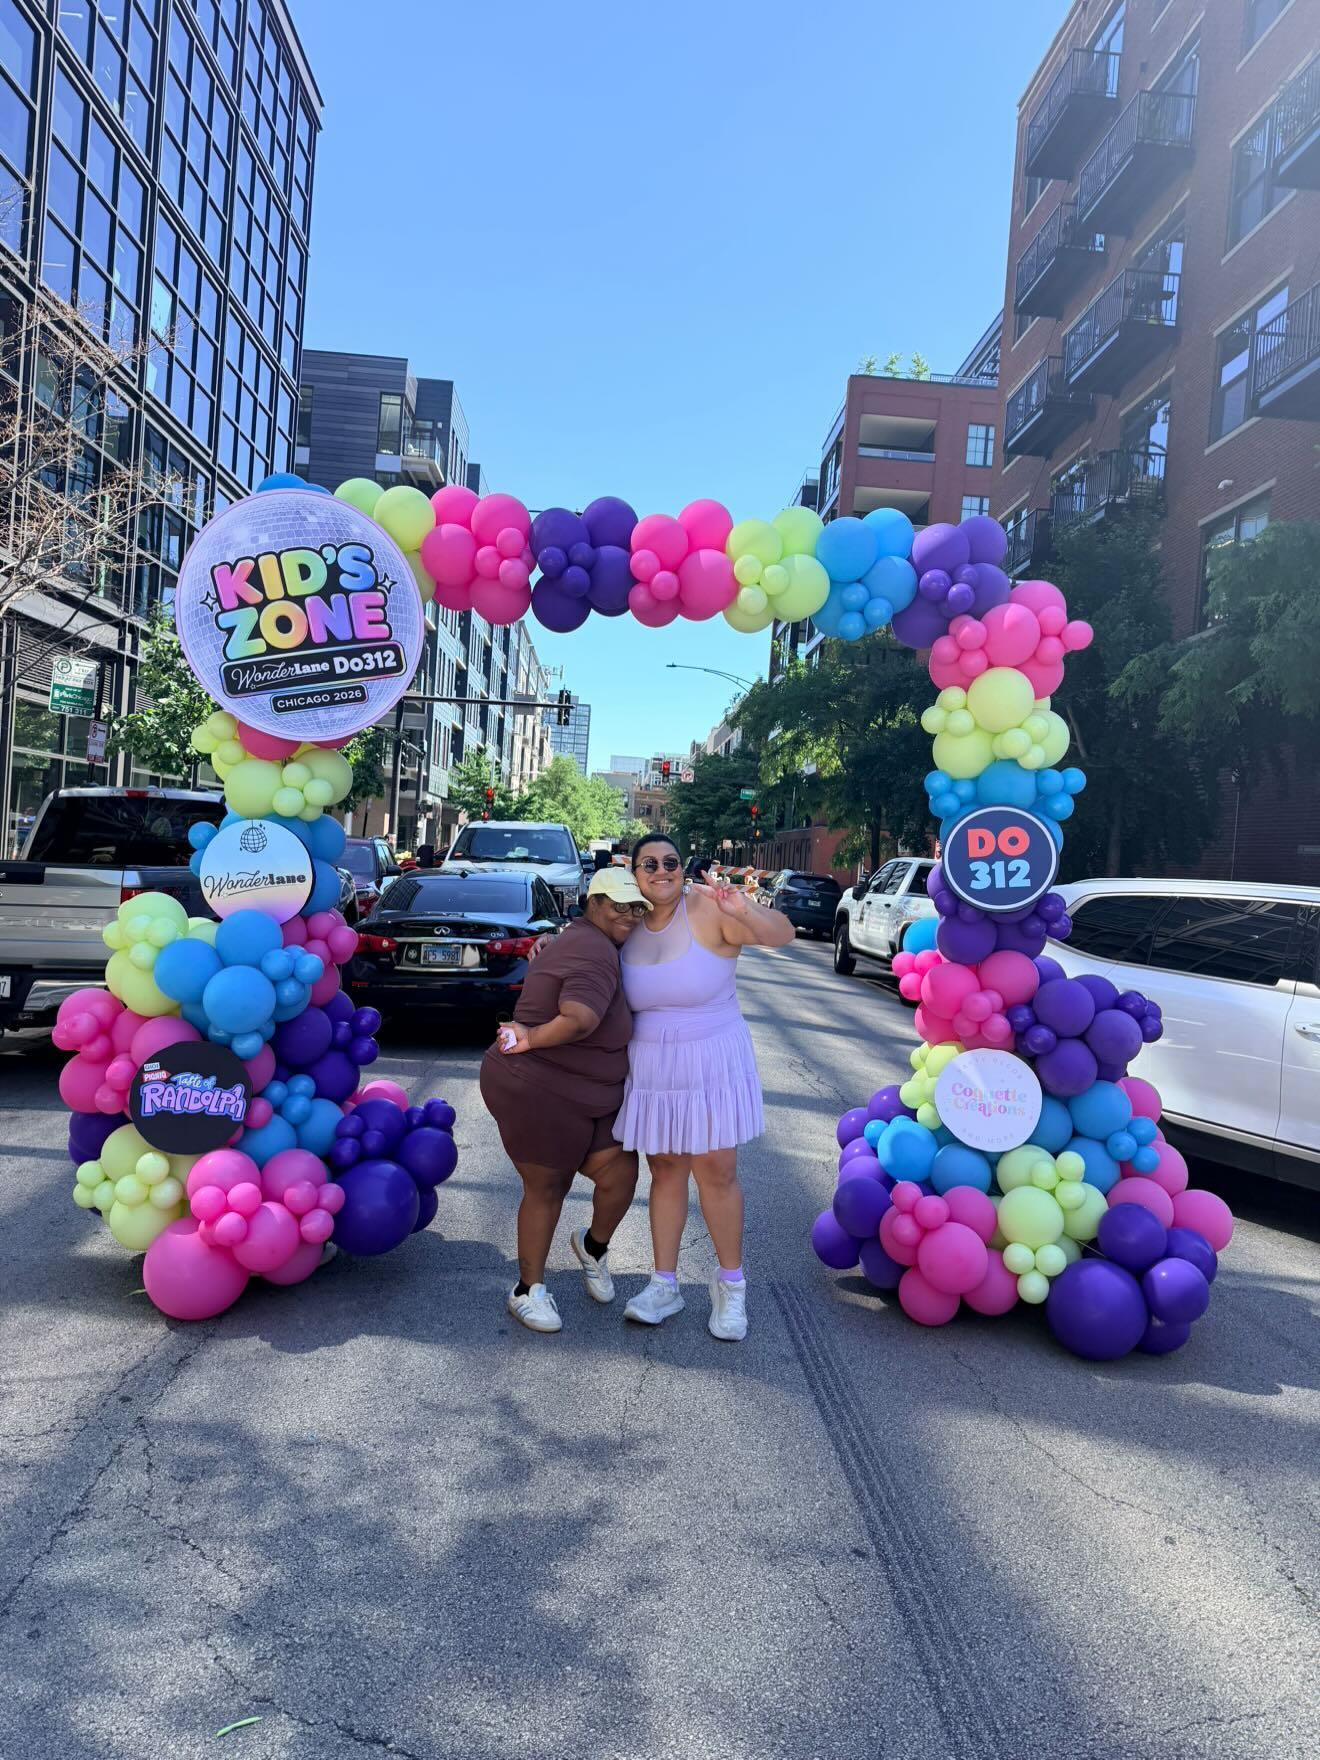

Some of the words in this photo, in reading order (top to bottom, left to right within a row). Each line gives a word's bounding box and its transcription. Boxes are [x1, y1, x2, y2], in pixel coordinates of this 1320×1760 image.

[213, 545, 377, 610] KID'S
[218, 591, 390, 660] ZONE
[333, 650, 397, 675] Do312
[276, 694, 330, 709] CHICAGO
[334, 689, 362, 703] 2026
[967, 826, 1030, 858] DO
[204, 870, 306, 899] Wonderlane
[969, 859, 1031, 890] 312
[172, 1073, 202, 1088] Taste
[203, 1077, 216, 1090] of
[953, 1097, 1025, 1118] Creations
